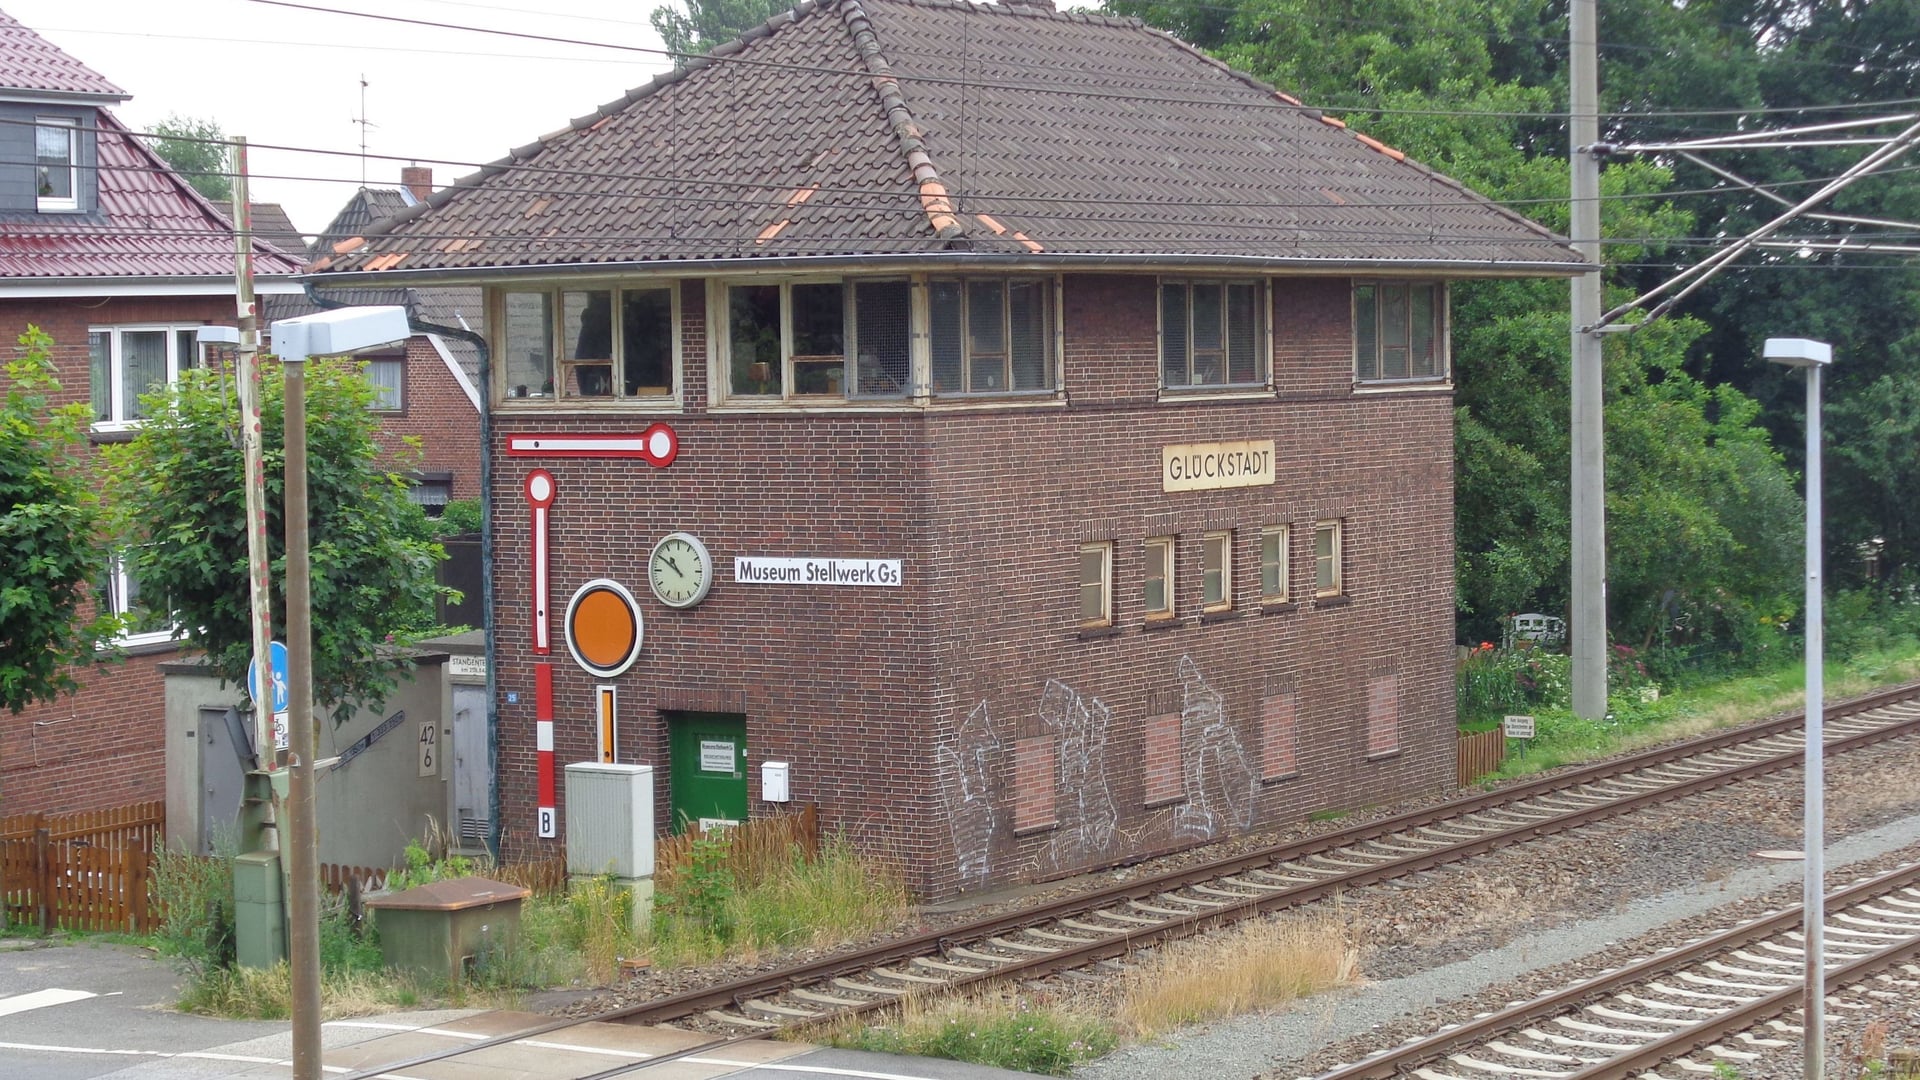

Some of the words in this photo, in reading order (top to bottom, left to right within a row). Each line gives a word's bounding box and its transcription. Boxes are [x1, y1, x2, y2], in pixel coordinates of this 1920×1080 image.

[1169, 450, 1269, 480] GLÜCKSTADT
[739, 561, 801, 582] Museum
[806, 561, 875, 583] Stellwerk
[878, 563, 897, 583] Gs
[420, 725, 435, 745] 42
[424, 748, 432, 768] 6
[541, 811, 551, 834] B
